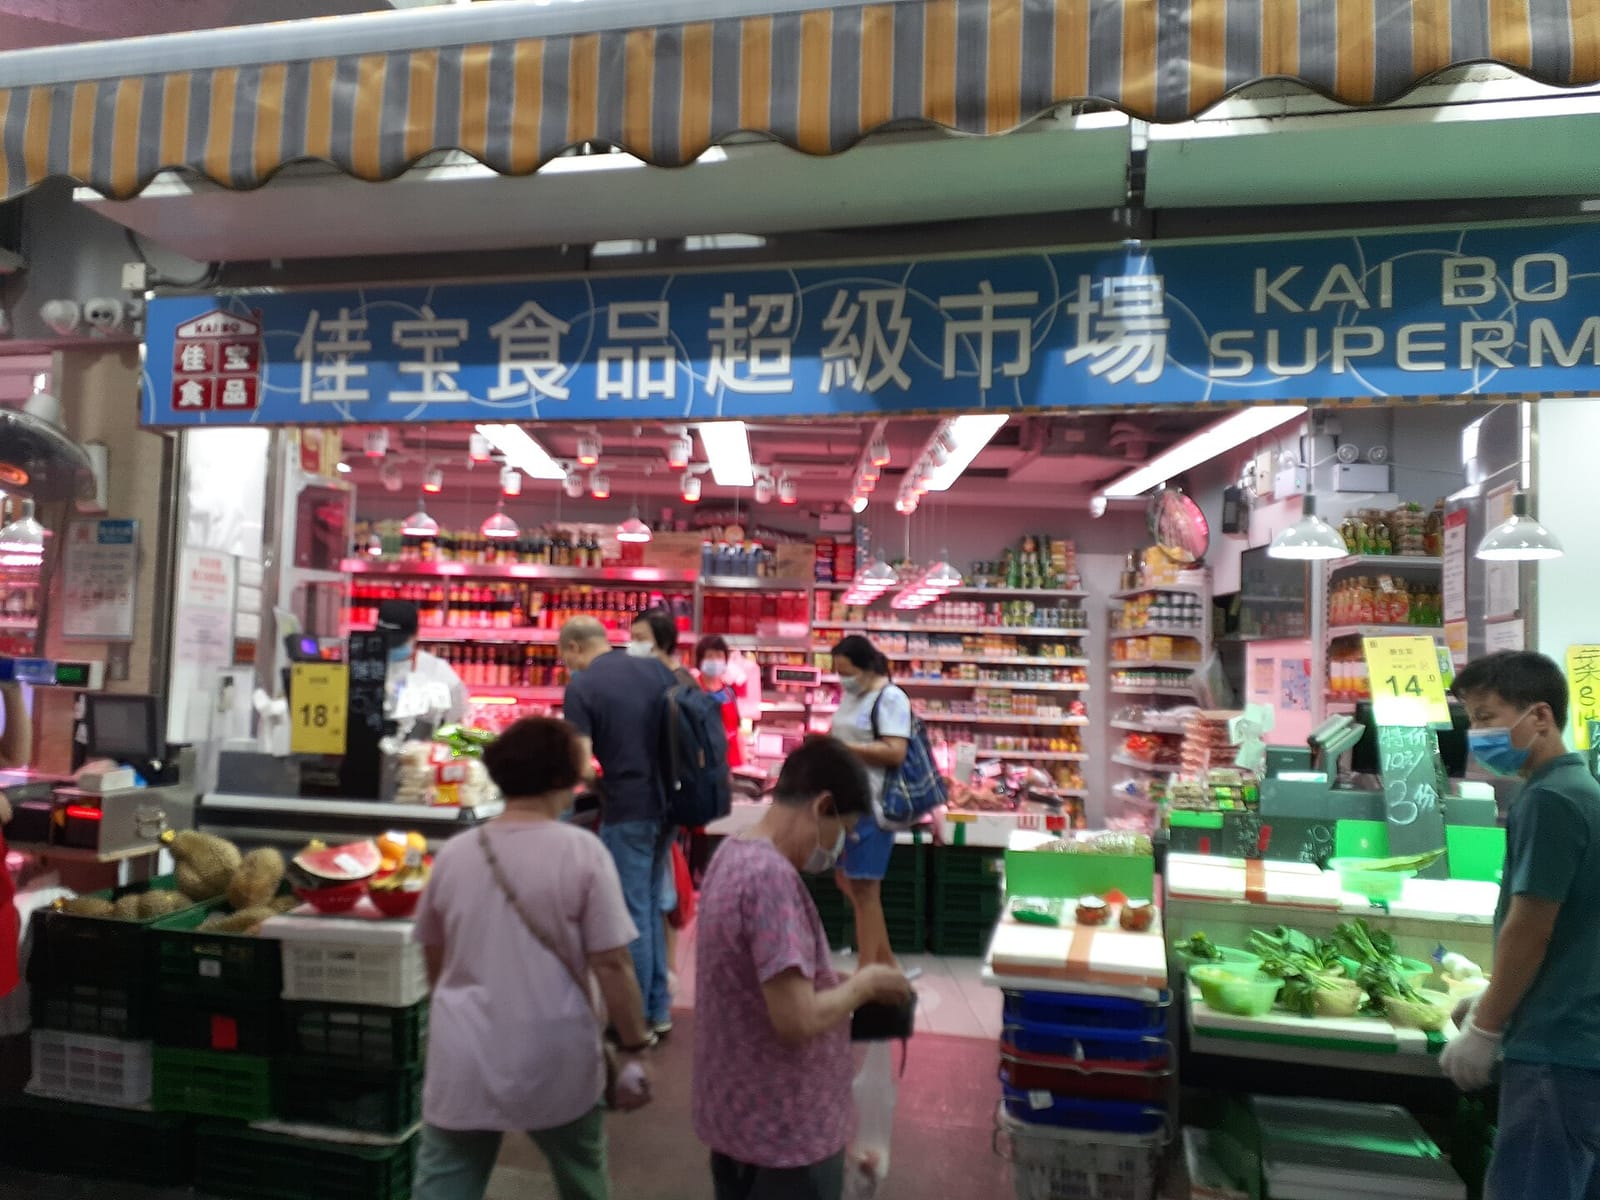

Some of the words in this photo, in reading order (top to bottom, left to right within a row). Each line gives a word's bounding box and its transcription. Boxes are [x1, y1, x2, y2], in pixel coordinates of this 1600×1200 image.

[1254, 262, 1392, 314] KAI
[1441, 253, 1568, 307] BO
[294, 274, 1170, 405] 佳宝食品超級市場
[1208, 316, 1600, 378] SUPERM
[178, 379, 248, 407] 食品
[1385, 674, 1424, 697] 14
[301, 704, 328, 727] 18
